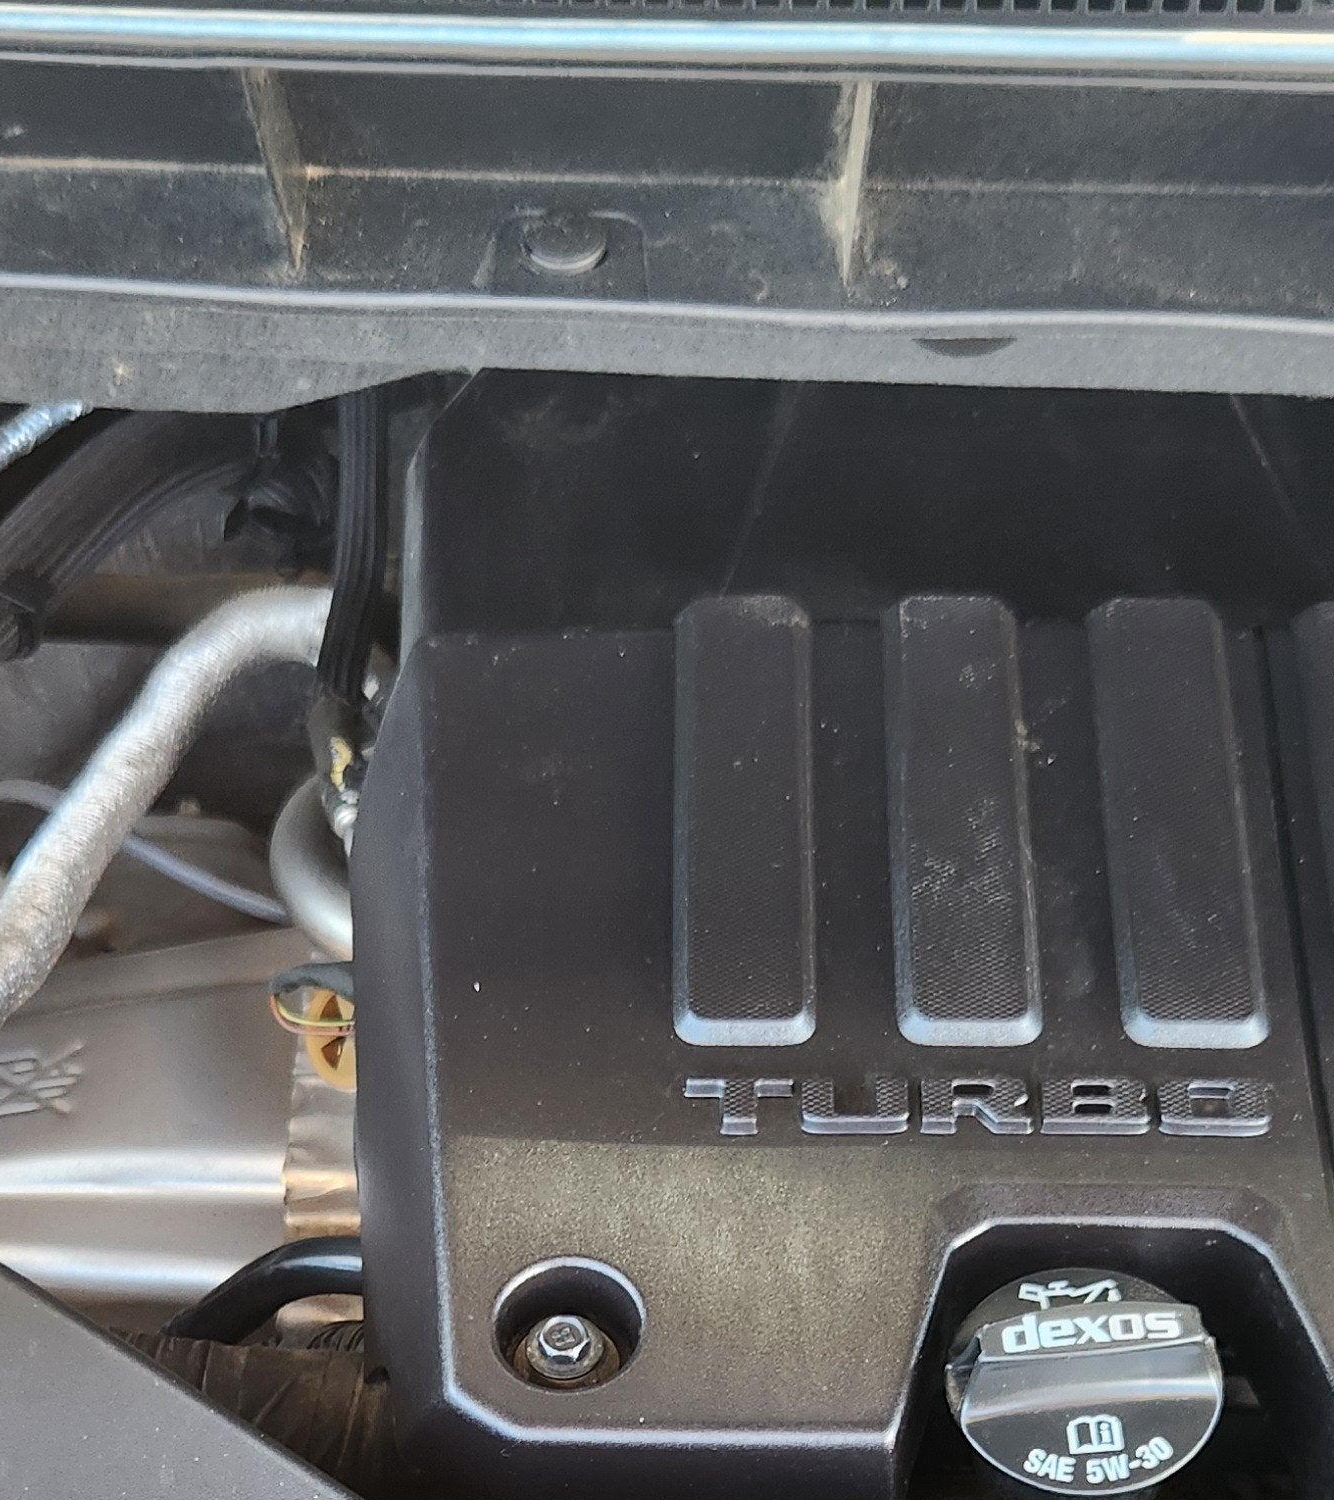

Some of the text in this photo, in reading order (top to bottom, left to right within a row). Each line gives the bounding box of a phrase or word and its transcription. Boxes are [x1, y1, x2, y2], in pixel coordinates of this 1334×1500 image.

[683, 1077, 1271, 1136] TURBO
[1001, 1311, 1183, 1354] dexos
[1023, 1436, 1175, 1484] SAE 5W-30
